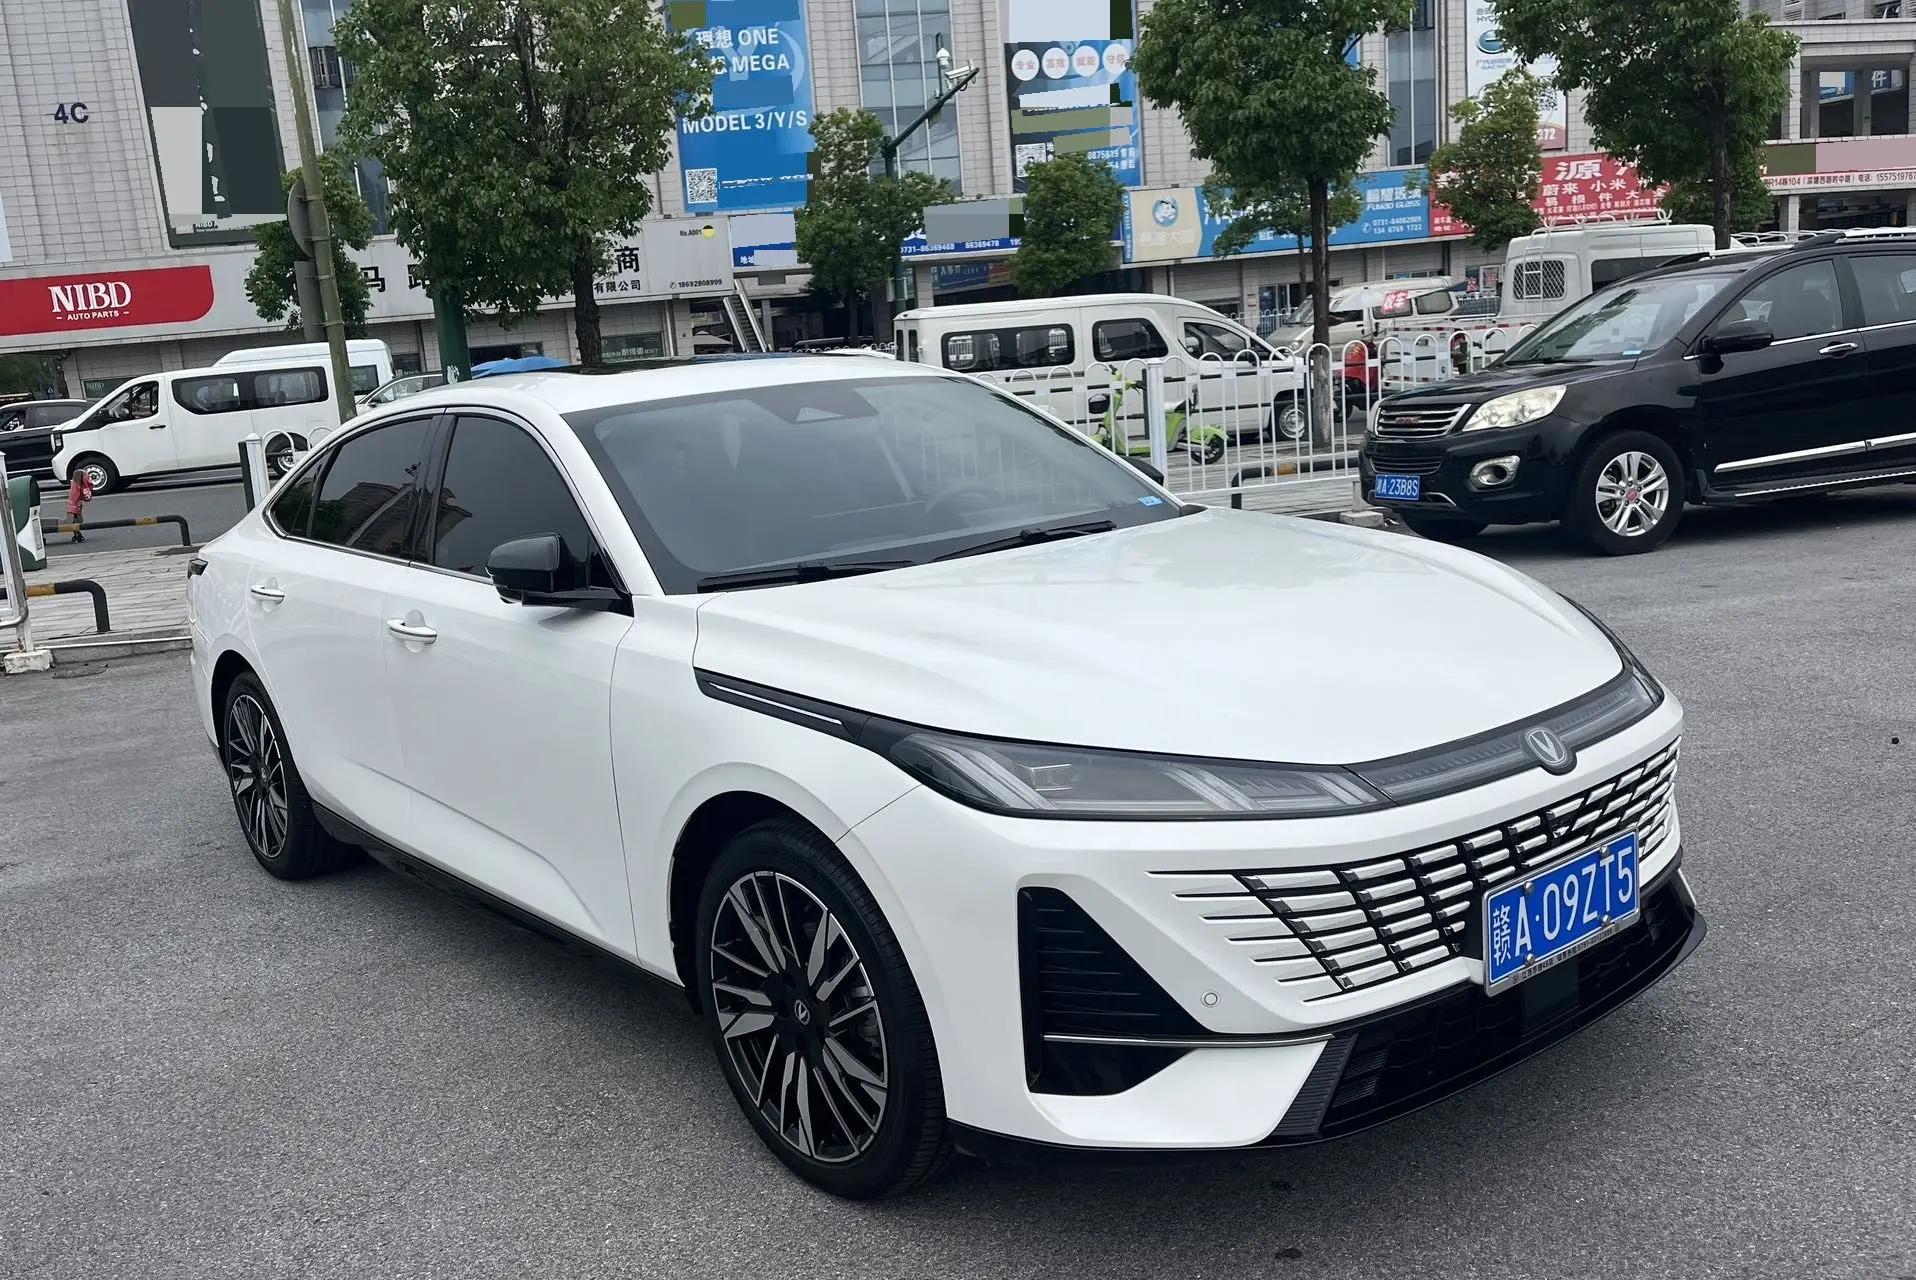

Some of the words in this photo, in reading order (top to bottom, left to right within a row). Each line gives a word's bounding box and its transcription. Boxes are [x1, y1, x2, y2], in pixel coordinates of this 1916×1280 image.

[695, 29, 733, 49] 理想
[737, 28, 779, 46] ONE
[732, 53, 790, 73] MEGA
[54, 102, 89, 124] 4C
[682, 114, 751, 134] MODEL
[754, 110, 807, 130] 3/Y/S
[1555, 159, 1602, 181] 源
[1589, 177, 1628, 193] 小米
[613, 245, 640, 274] 商
[48, 281, 132, 313] NIBD
[594, 279, 641, 294] 有限公司
[67, 312, 91, 321] AUTO
[92, 310, 120, 319] PARTS
